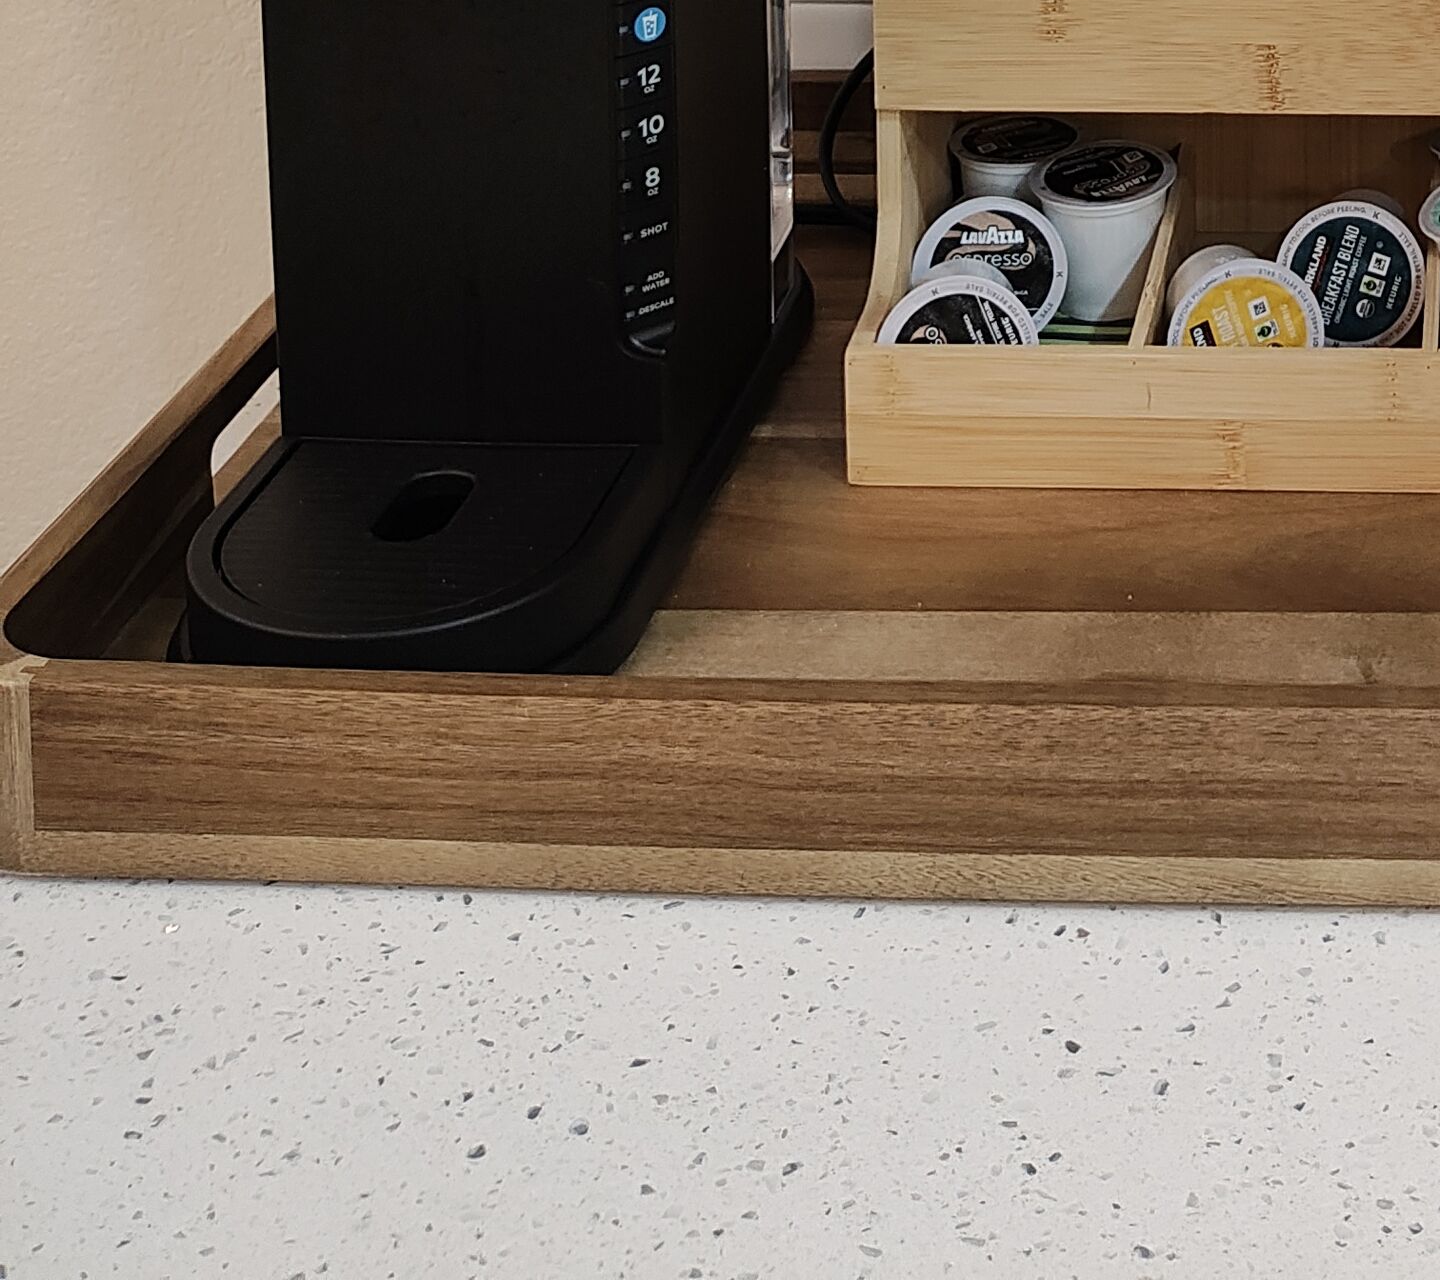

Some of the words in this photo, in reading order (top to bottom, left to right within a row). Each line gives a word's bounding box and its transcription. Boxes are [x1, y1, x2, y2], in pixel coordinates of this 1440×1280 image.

[637, 64, 662, 87] 12
[644, 85, 656, 94] OZ
[638, 114, 665, 138] 10
[646, 136, 658, 145] OZ
[645, 167, 661, 188] 8
[648, 187, 659, 196] OZ
[640, 221, 669, 239] SHOT
[1296, 222, 1311, 237] COOL
[1310, 207, 1336, 223] BEFORE
[1336, 205, 1367, 214] PEELING
[959, 226, 1025, 245] LAVAZZA
[1399, 232, 1412, 248] SALE
[951, 251, 1033, 269] espresso
[1304, 235, 1327, 288] RKLAND
[1410, 249, 1421, 274] RETAIL
[646, 270, 665, 282] ADD
[1258, 268, 1275, 277] SALE
[1277, 272, 1297, 290] RETAIL
[1321, 259, 1346, 326] BREAKFAST
[1337, 224, 1360, 262] BLEND
[1334, 293, 1347, 324] ORGANIC
[1343, 277, 1353, 297] LIGHT
[1348, 255, 1361, 279] ROAST
[1356, 234, 1367, 257] COFFEE
[641, 277, 670, 293] WATER
[965, 283, 984, 292] SALE
[1385, 274, 1402, 310] KEURIG
[638, 296, 675, 315] DESCALE
[986, 288, 1008, 306] RETAIL
[1406, 290, 1421, 318] LABELED
[1177, 300, 1193, 326] BEFORE
[1305, 302, 1319, 336] LABELED
